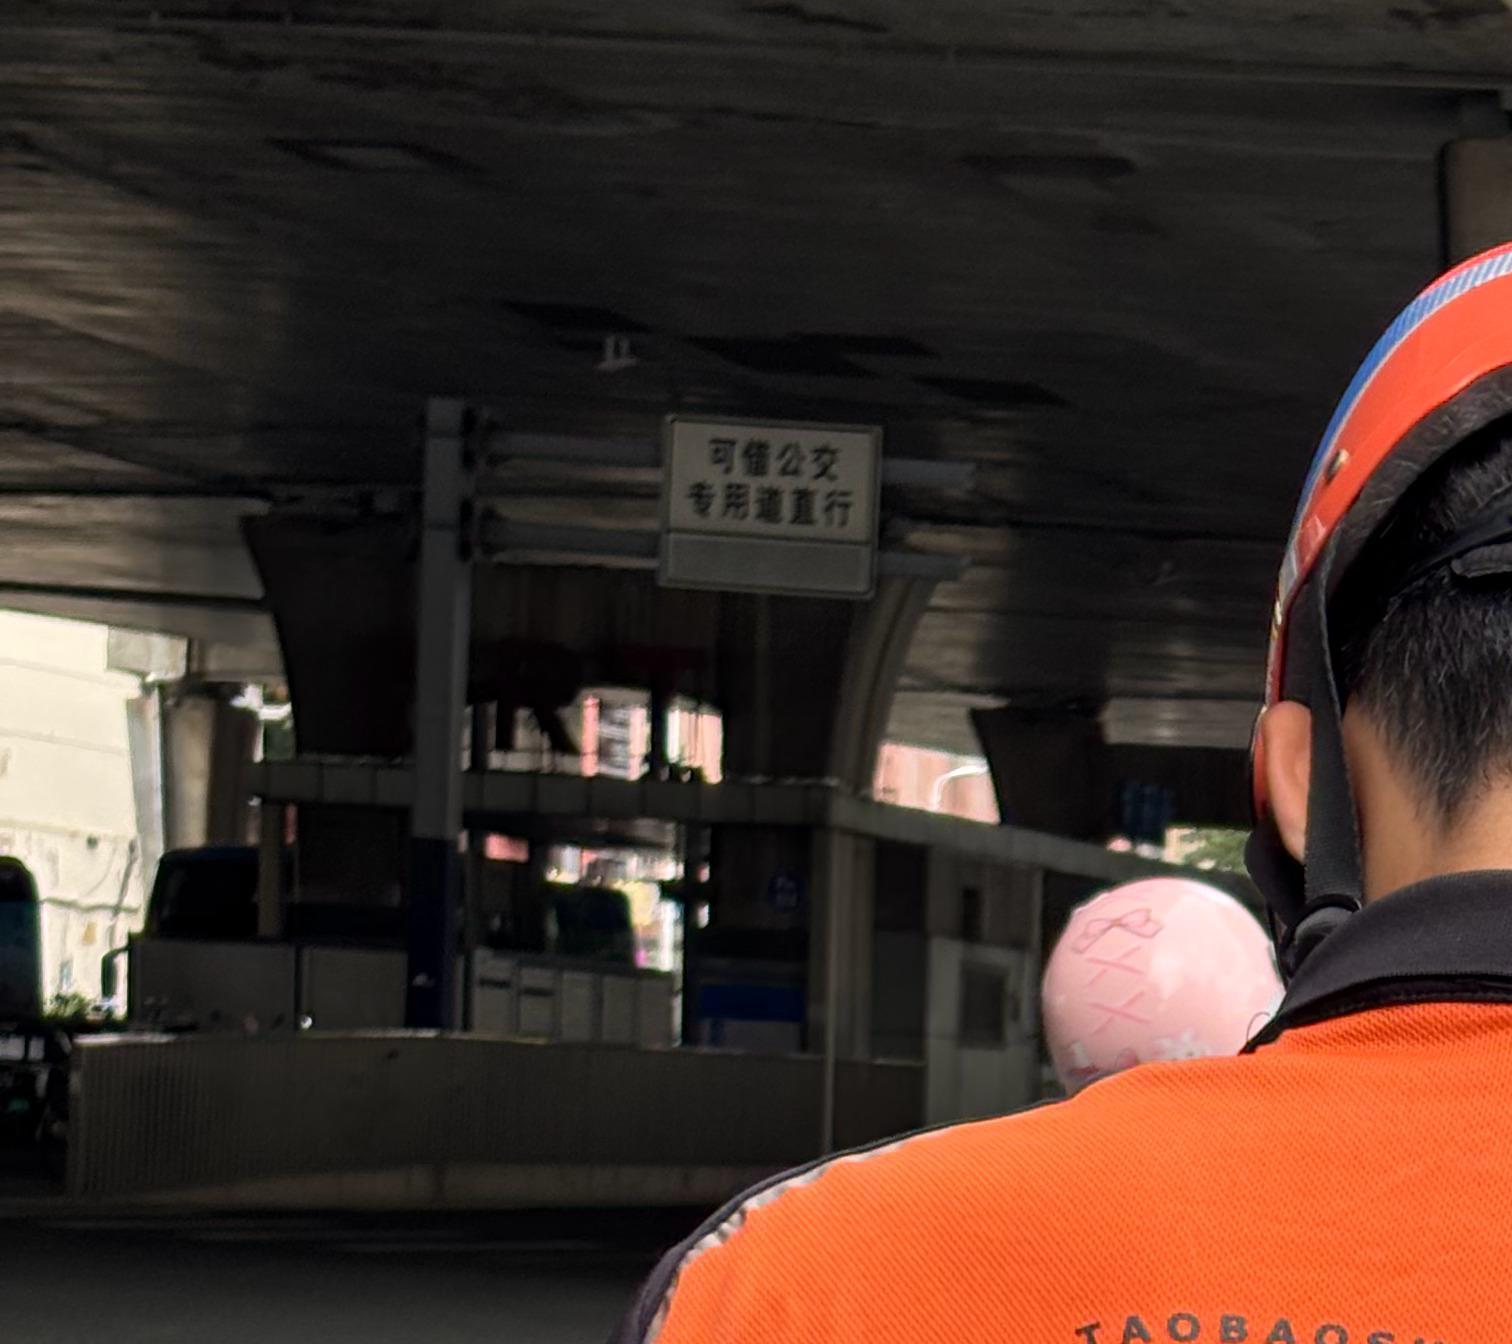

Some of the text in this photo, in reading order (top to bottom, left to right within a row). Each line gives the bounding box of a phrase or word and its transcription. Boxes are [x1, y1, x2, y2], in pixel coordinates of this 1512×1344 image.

[708, 437, 839, 482] 可借公交
[688, 480, 853, 528] 专用道直行
